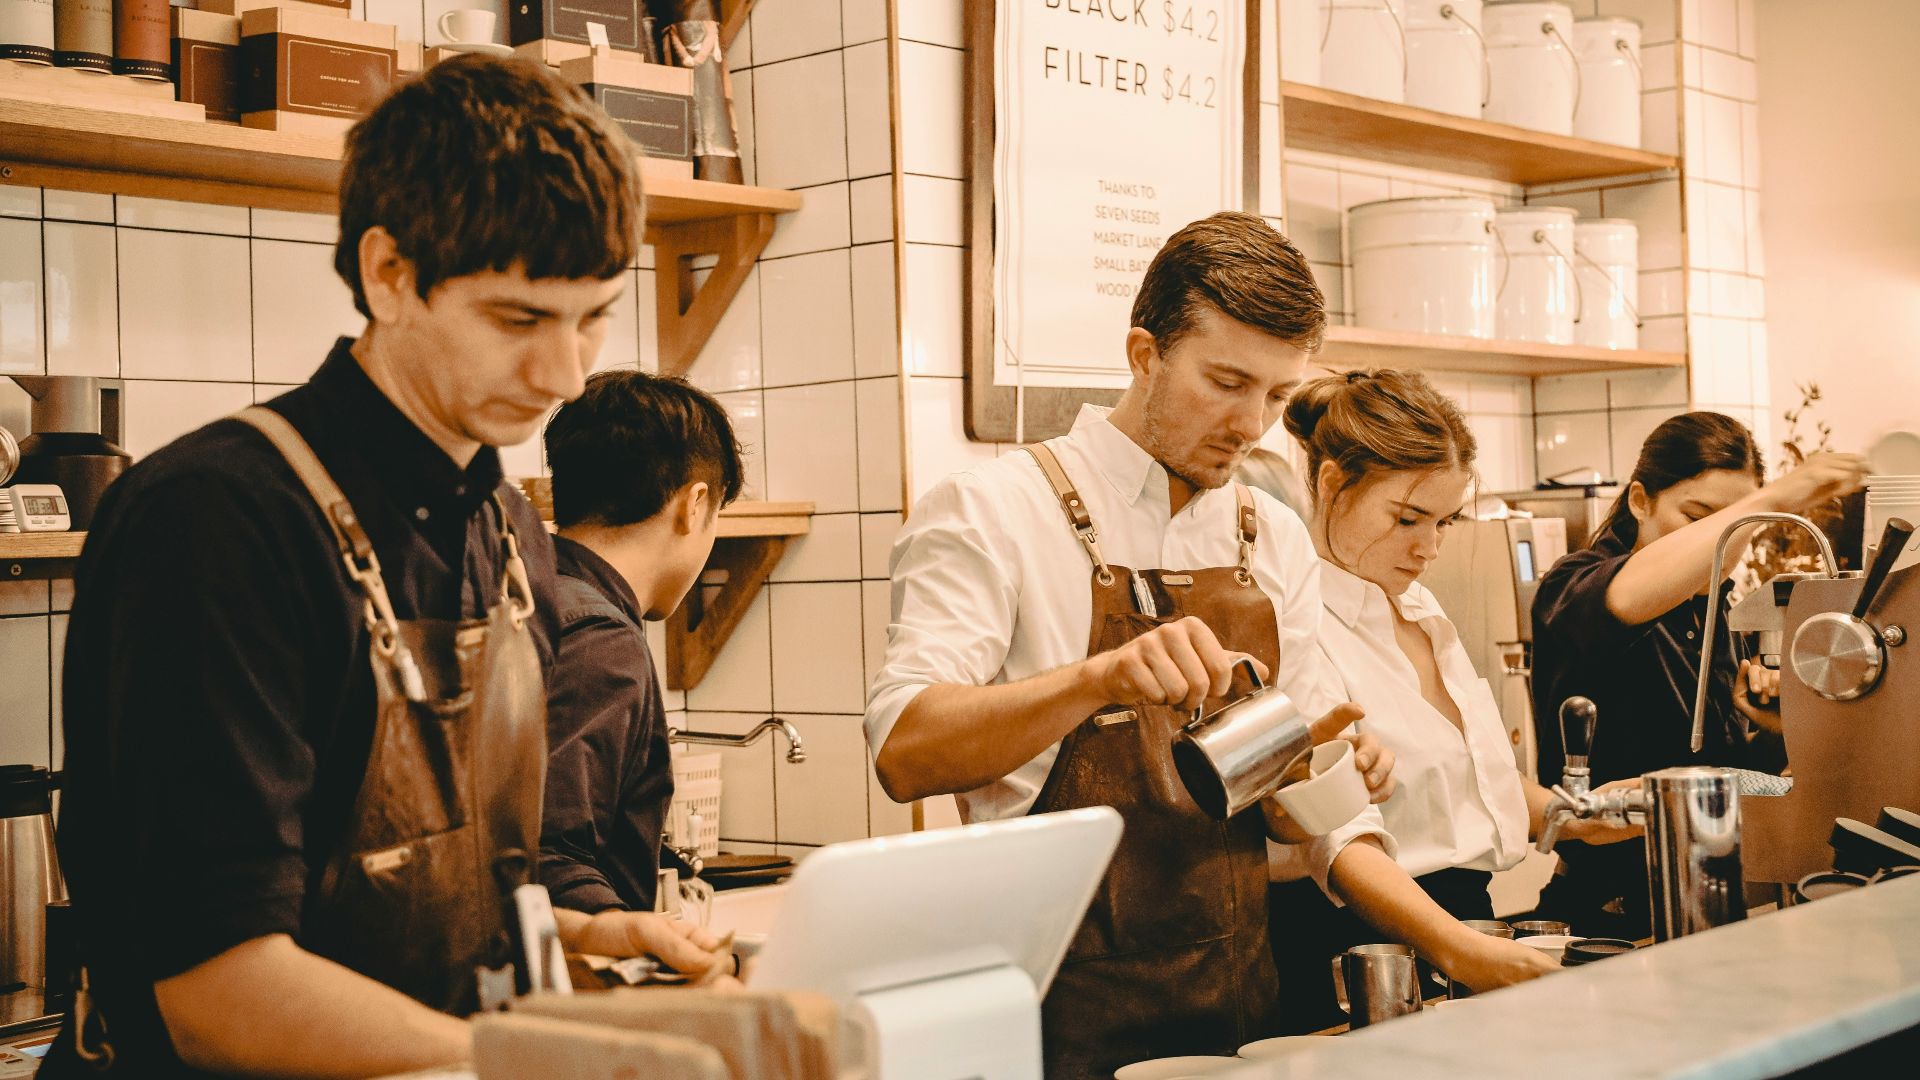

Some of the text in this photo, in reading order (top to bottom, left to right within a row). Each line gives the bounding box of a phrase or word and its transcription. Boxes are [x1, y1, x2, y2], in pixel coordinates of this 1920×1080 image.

[1046, 0, 1218, 42] ACK $4.2
[1045, 46, 1216, 109] FILTER $4.2
[1098, 180, 1138, 198] THANKS
[1095, 205, 1160, 226] SEVEN SEEDS
[1094, 231, 1162, 250] MARKET LANE
[1093, 256, 1149, 273] SMALL BAT
[1096, 282, 1131, 298] WOOD
